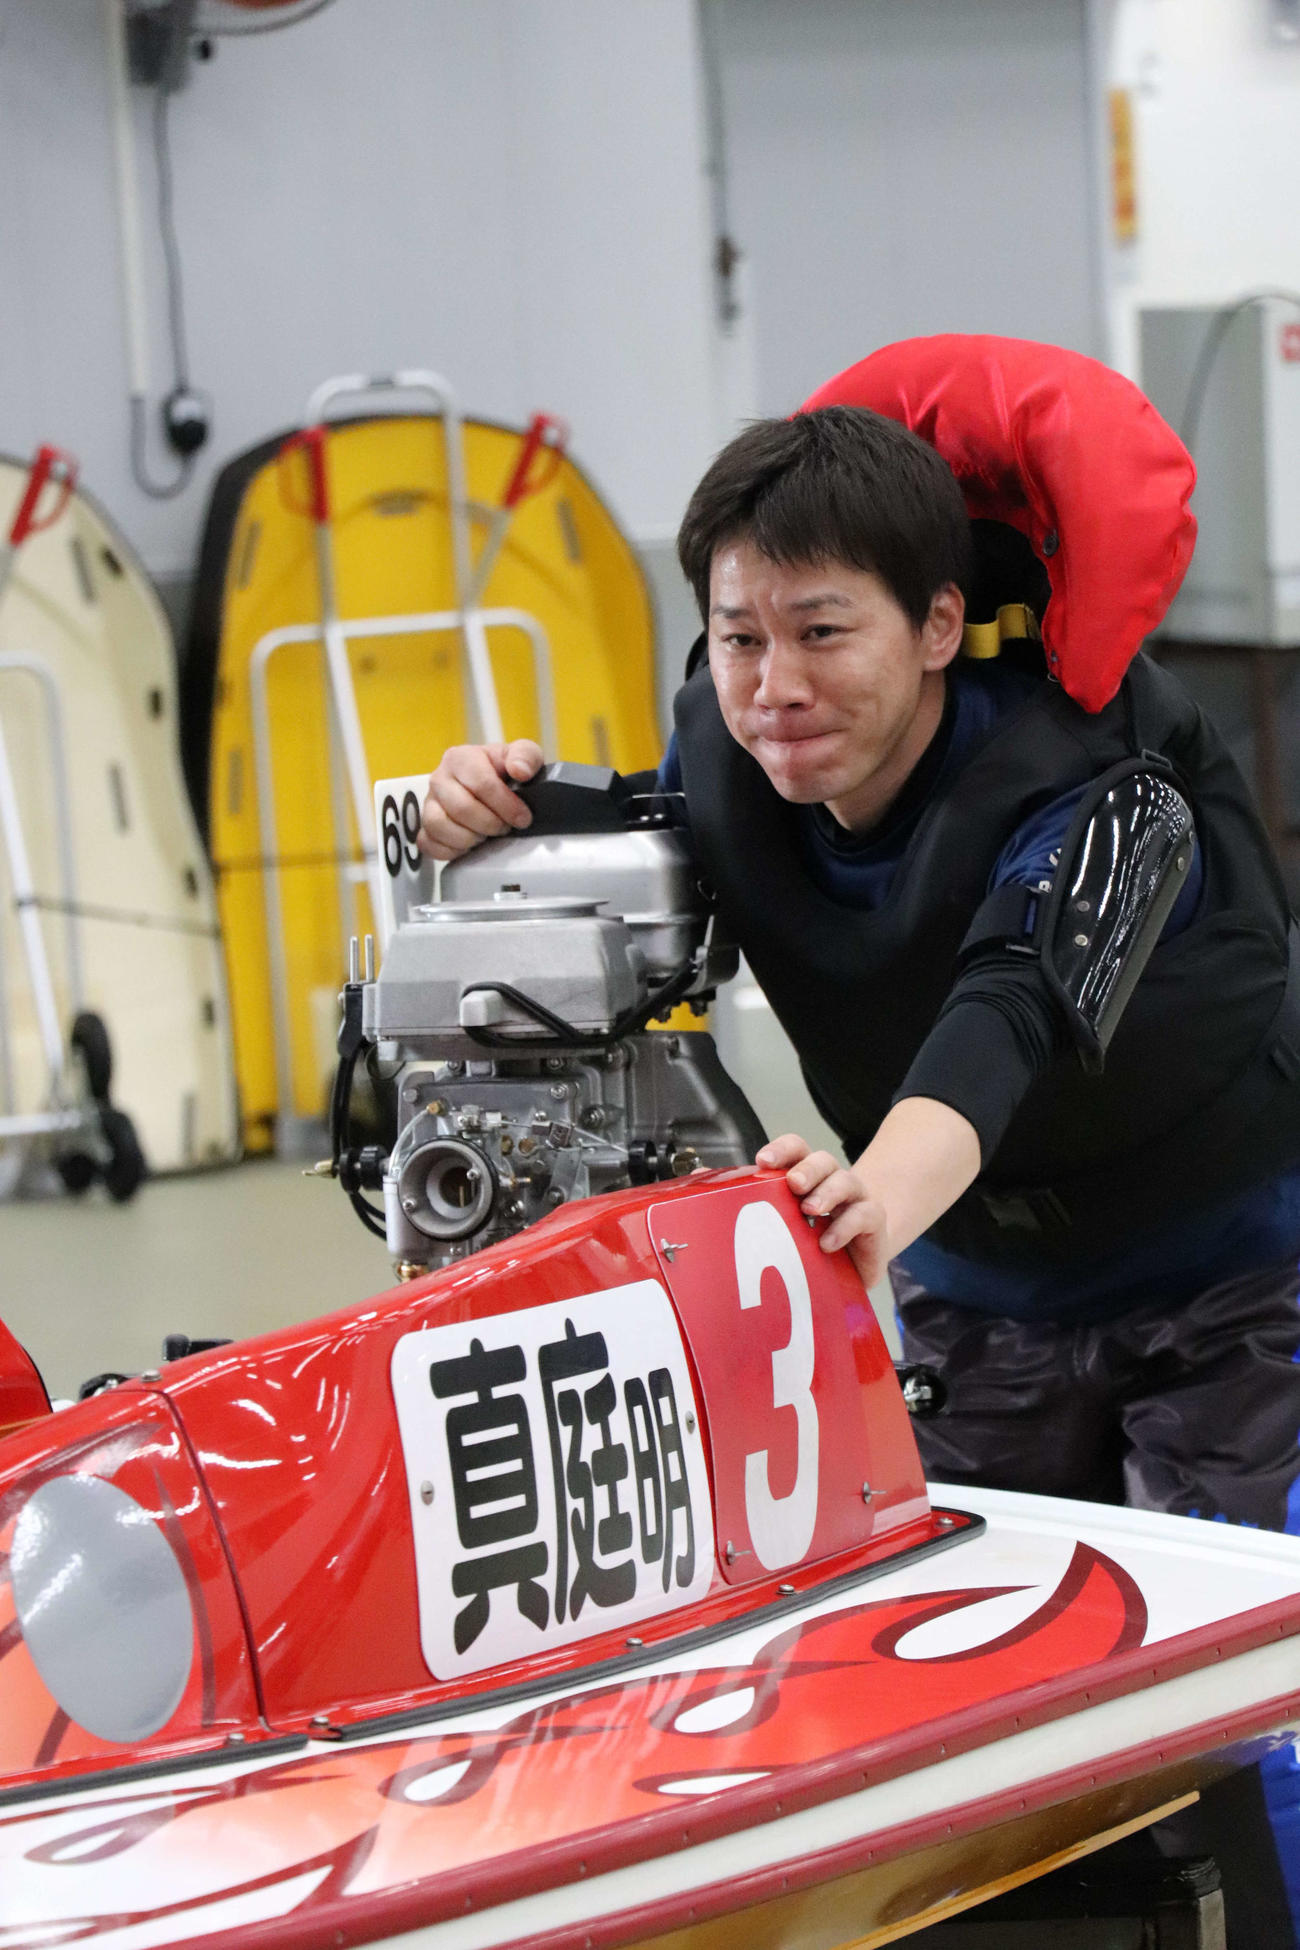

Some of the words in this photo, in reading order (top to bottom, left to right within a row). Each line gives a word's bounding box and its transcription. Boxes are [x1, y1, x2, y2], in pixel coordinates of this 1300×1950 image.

[382, 790, 422, 877] 69
[429, 1317, 696, 1655] 真庭明
[733, 1200, 820, 1571] 3
